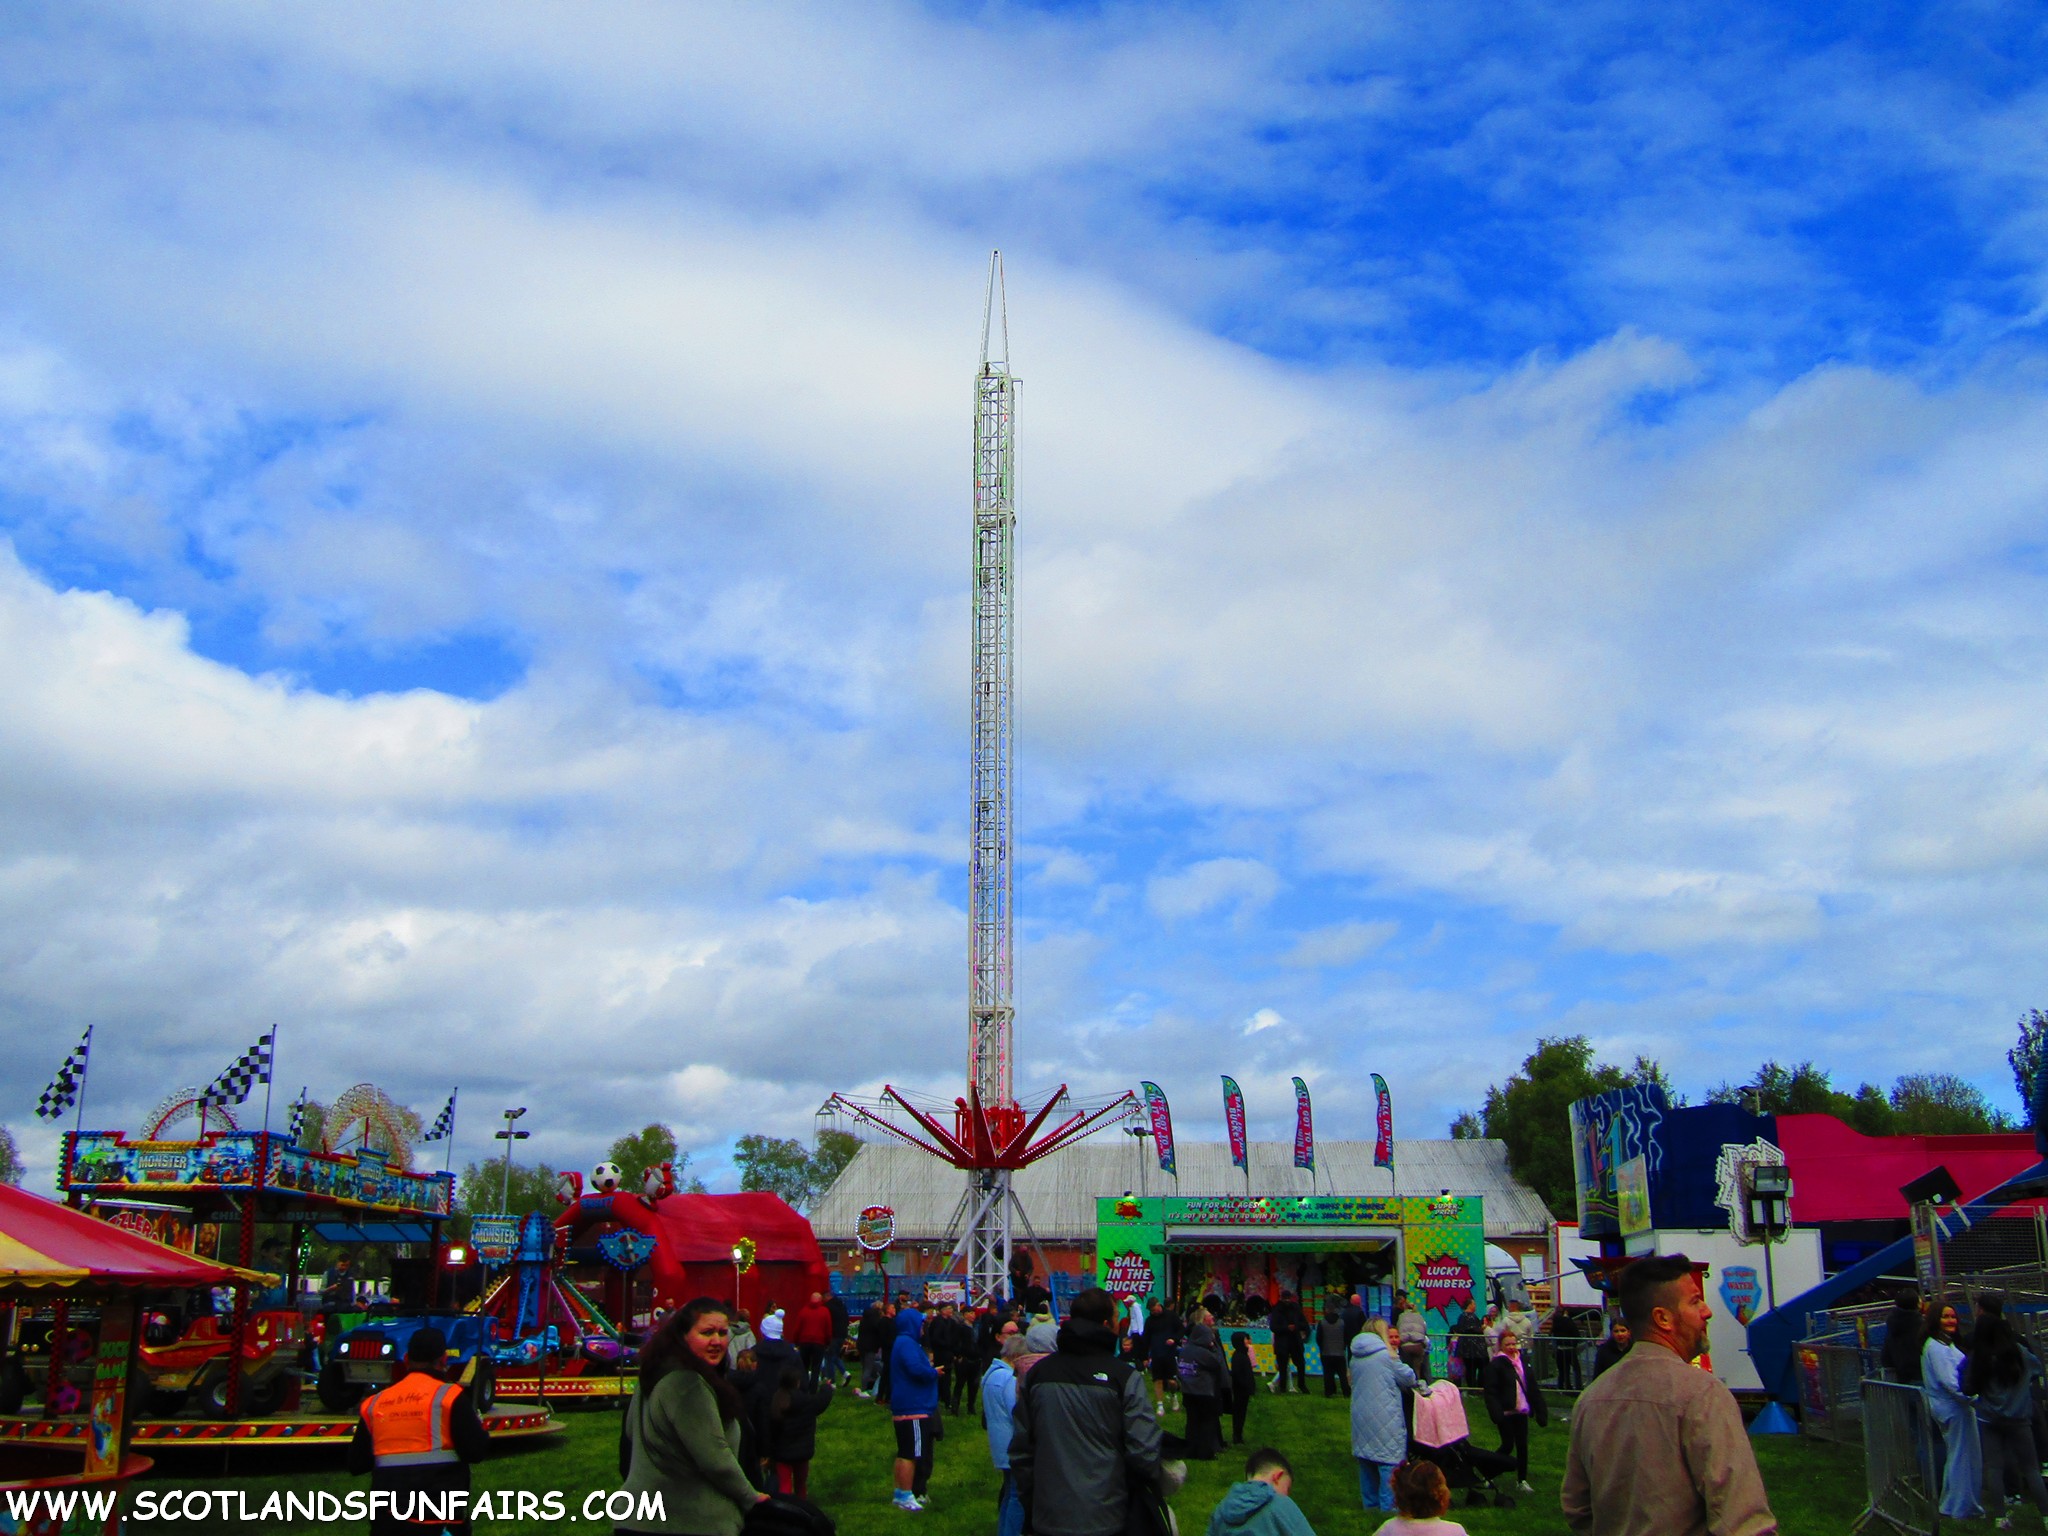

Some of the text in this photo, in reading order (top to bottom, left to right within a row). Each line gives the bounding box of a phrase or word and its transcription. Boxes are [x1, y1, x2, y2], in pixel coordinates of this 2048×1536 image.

[1382, 1093, 1390, 1116] BALL
[1159, 1114, 1168, 1131] GOT
[1229, 1107, 1239, 1142] BUCKET
[1303, 1110, 1311, 1128] GOT
[1383, 1120, 1391, 1131] IN
[1162, 1134, 1169, 1146] TO
[1297, 1129, 1305, 1147] WIN
[1305, 1131, 1312, 1143] TO
[1163, 1148, 1171, 1160] BE
[1306, 1146, 1313, 1158] BE
[138, 1154, 188, 1169] MONSTER
[1186, 1201, 1200, 1209] FUN
[1204, 1201, 1220, 1209] FOR
[1222, 1201, 1235, 1209] ALL
[475, 1227, 516, 1245] MONSTER
[1113, 1256, 1144, 1268] BALL
[1106, 1268, 1151, 1280] IN THE
[1426, 1266, 1462, 1276] LUCKY
[1105, 1280, 1155, 1293] BUCKET
[1416, 1278, 1474, 1289] NUMBERS
[1727, 1282, 1753, 1290] WATER
